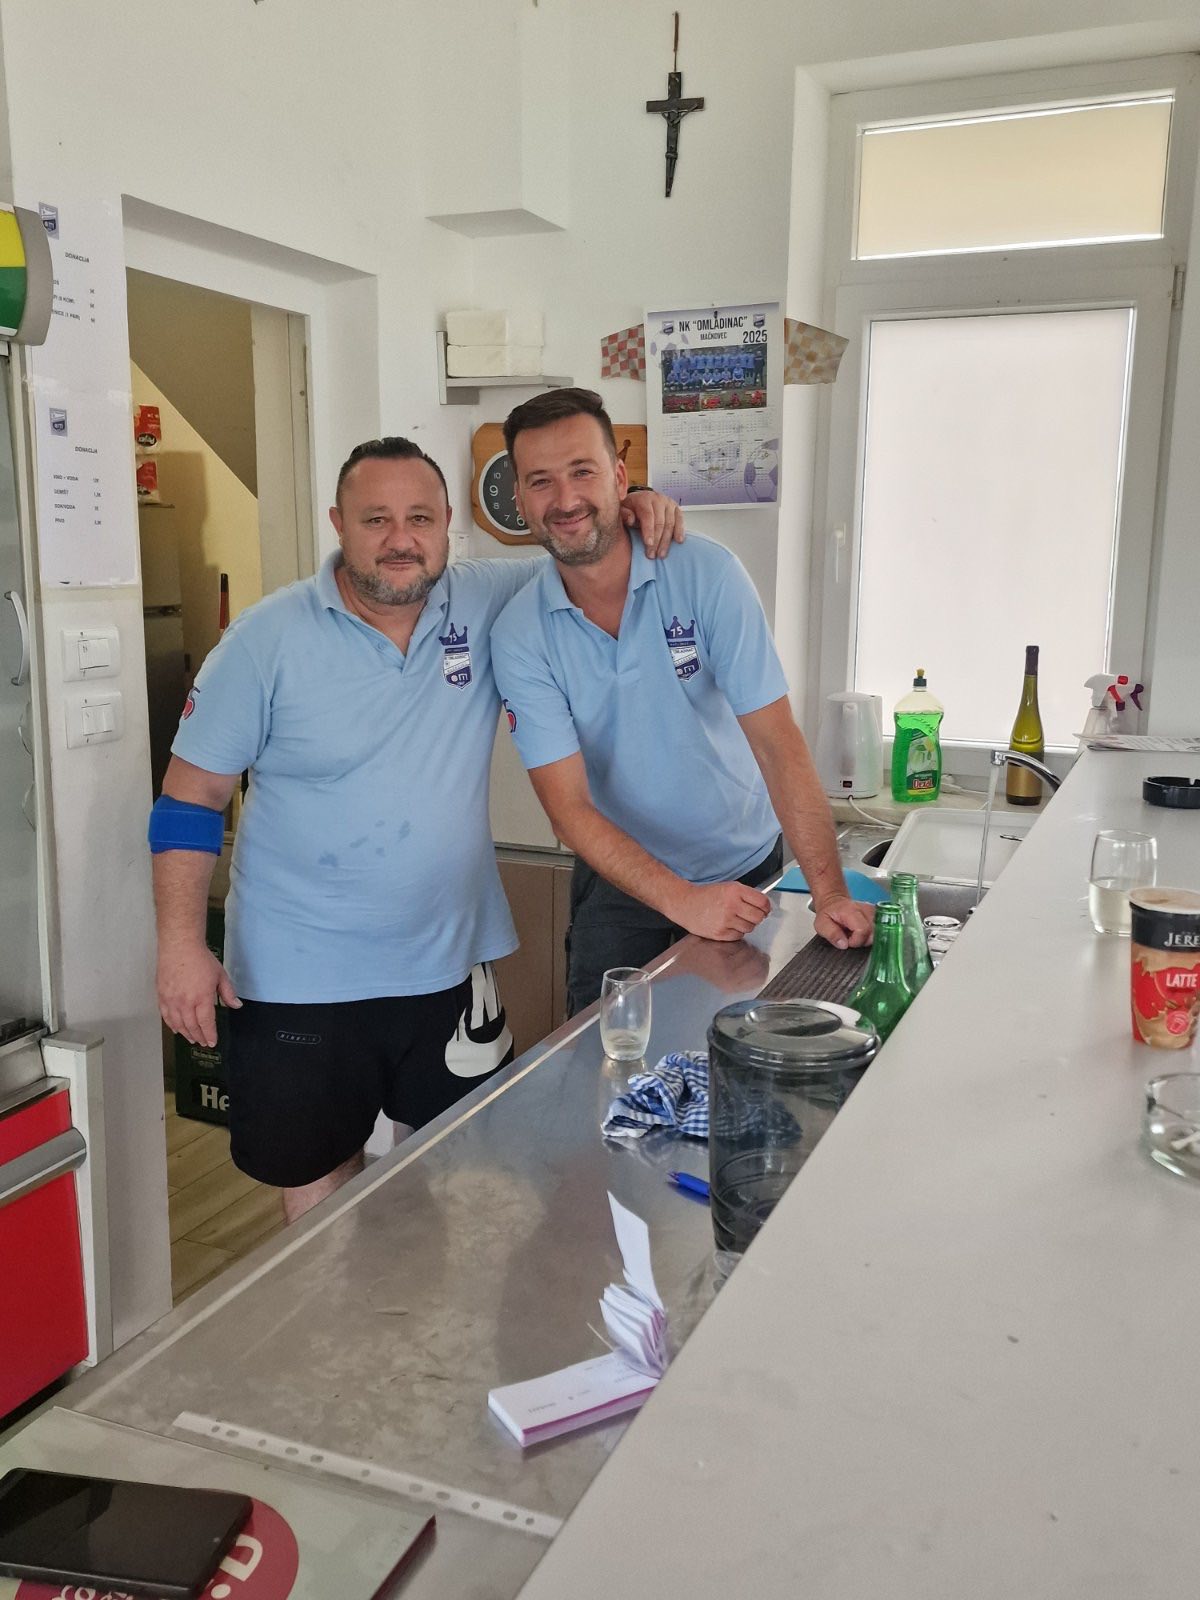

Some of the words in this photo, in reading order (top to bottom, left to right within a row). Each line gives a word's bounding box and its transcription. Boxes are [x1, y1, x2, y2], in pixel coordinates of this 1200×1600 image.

[65, 252, 89, 262] DONACIJA
[679, 321, 690, 333] NK
[742, 329, 768, 344] 2025
[74, 446, 98, 454] DONACIJA
[493, 472, 502, 480] 10
[489, 485, 498, 496] 9
[517, 514, 525, 526] 6
[670, 626, 683, 638] 75
[1166, 973, 1198, 987] LATTE
